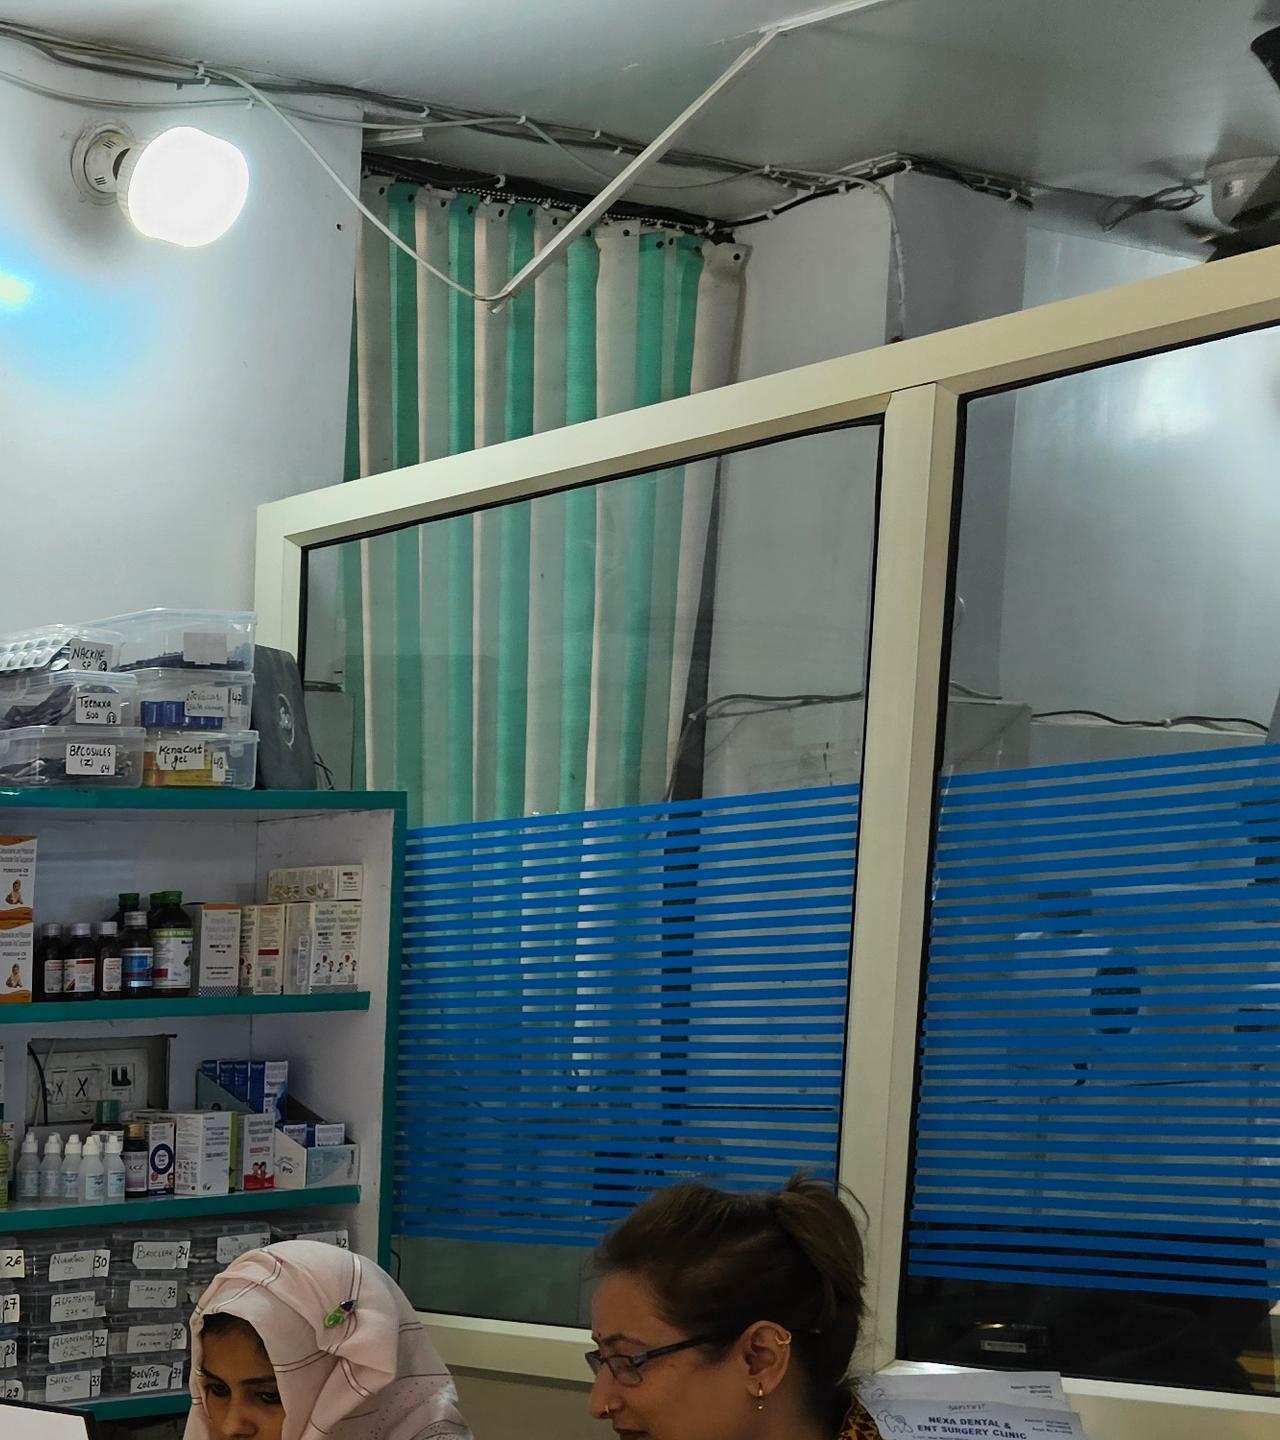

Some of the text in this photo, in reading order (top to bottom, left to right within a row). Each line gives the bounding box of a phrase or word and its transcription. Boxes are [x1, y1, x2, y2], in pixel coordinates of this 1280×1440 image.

[928, 1416, 1000, 1428] NEXA DENTAL
[941, 1426, 990, 1436] SURGERY
[993, 1429, 1027, 1439] CLINIC
